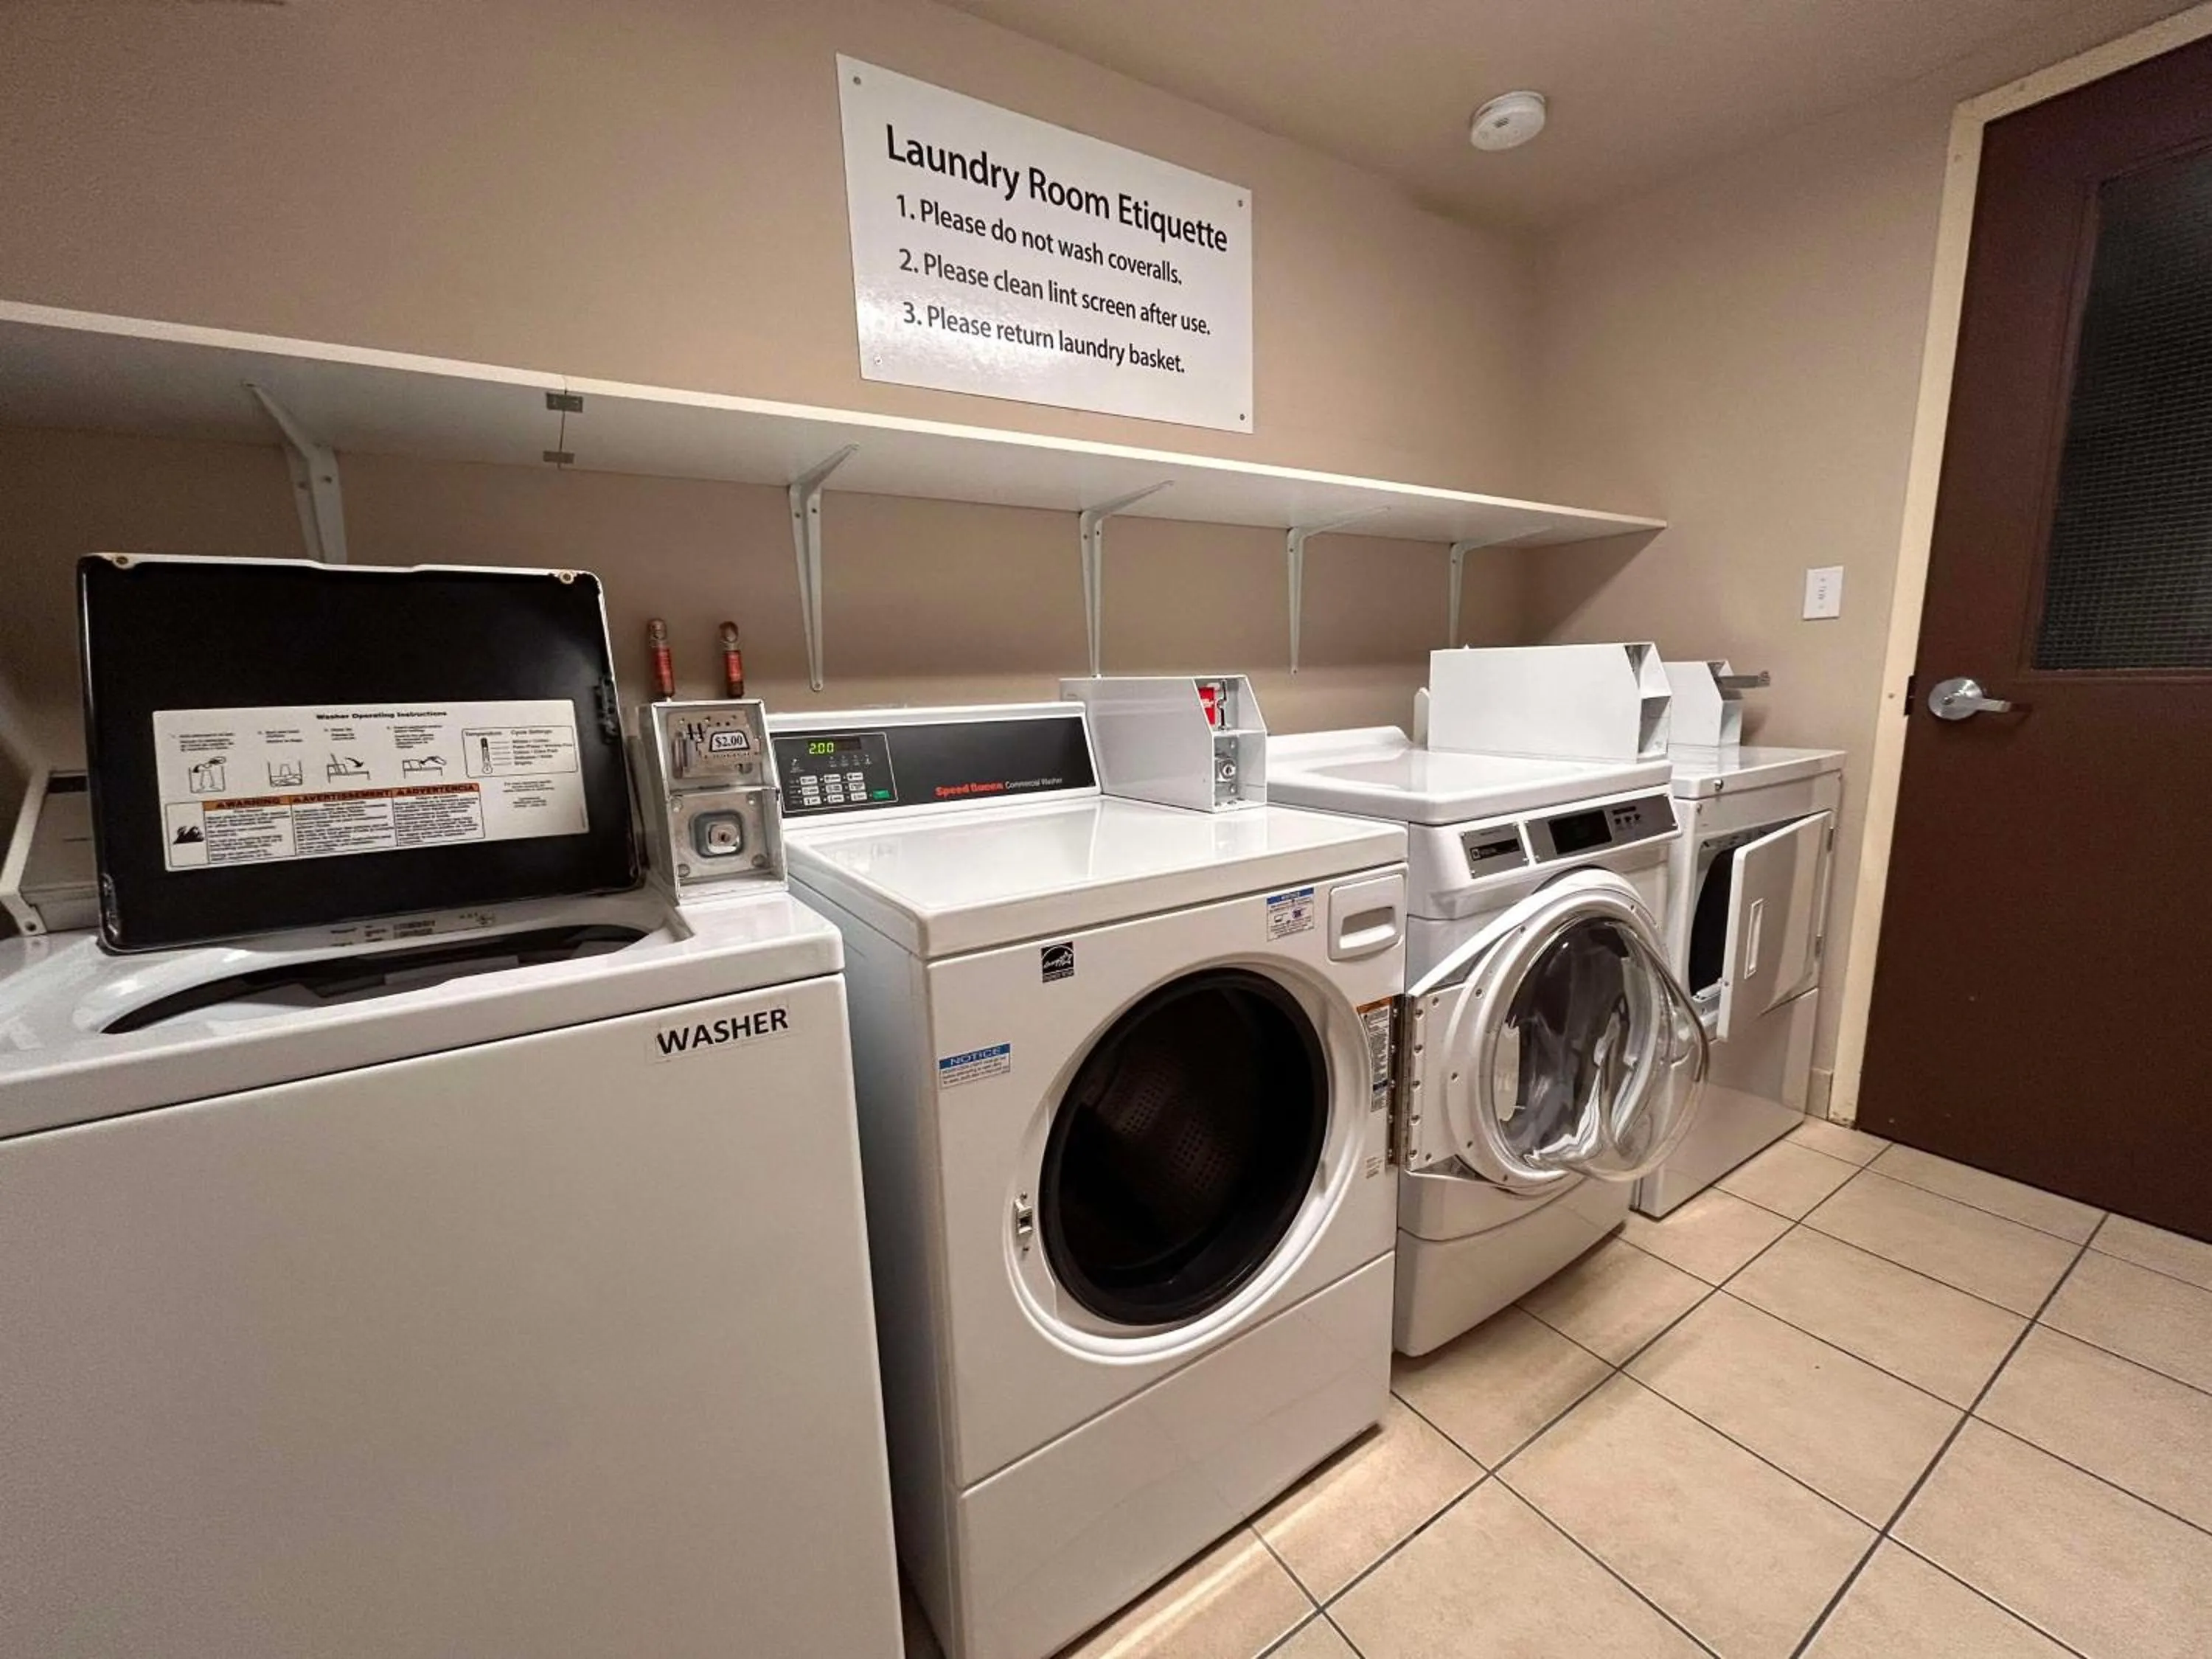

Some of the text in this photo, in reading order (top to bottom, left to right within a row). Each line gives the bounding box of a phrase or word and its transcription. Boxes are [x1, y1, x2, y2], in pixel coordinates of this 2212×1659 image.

[886, 123, 1228, 253] Laundry Room Etiquette
[896, 194, 1183, 285] 1. Please do not wash coveralls.
[899, 248, 1211, 335] 2. Please clean lint screen after use.
[902, 301, 1185, 374] 3. Please return laundry basket.
[714, 735, 743, 748] $2.00
[809, 742, 834, 754] 2.00
[935, 784, 970, 797] Speed
[656, 1008, 789, 1054] WASHER
[950, 1047, 1001, 1065] NOTICE
